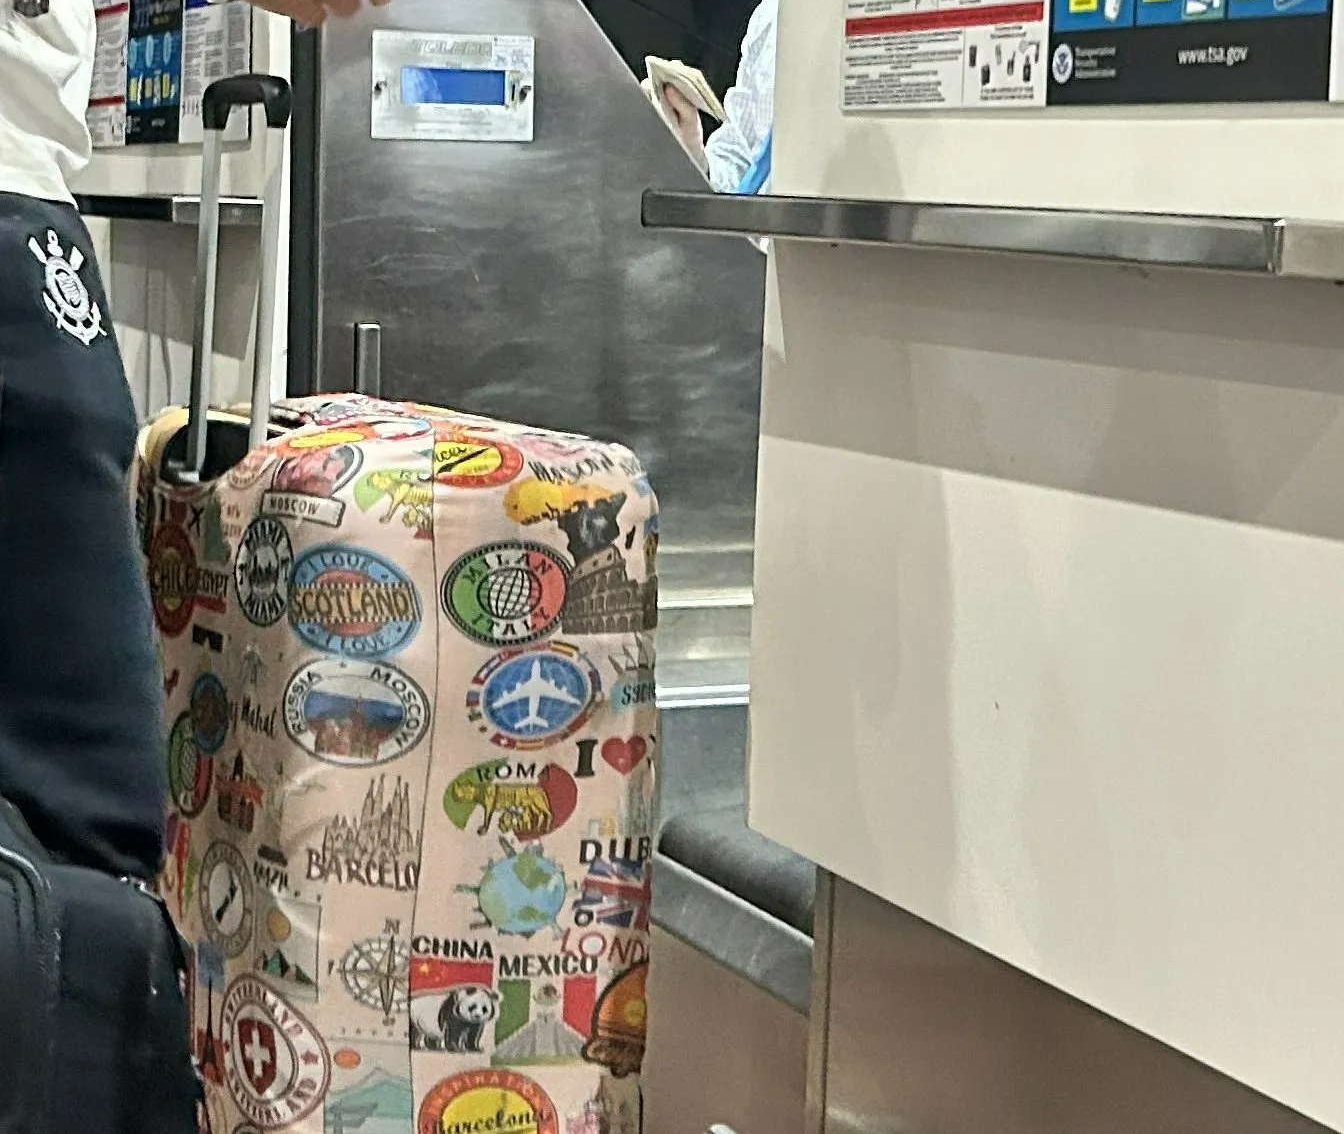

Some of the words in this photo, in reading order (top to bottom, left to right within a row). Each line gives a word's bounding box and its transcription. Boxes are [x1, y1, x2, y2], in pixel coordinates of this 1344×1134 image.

[1178, 45, 1249, 67] www.tsa.gov
[270, 497, 320, 516] MOSCOW
[292, 588, 411, 618] SCOTLAND
[291, 671, 323, 734] RUSSIA
[370, 667, 421, 748] MOSCOW
[476, 762, 553, 783] ROMA
[412, 934, 494, 959] CHINA
[499, 952, 599, 977] MEXICO
